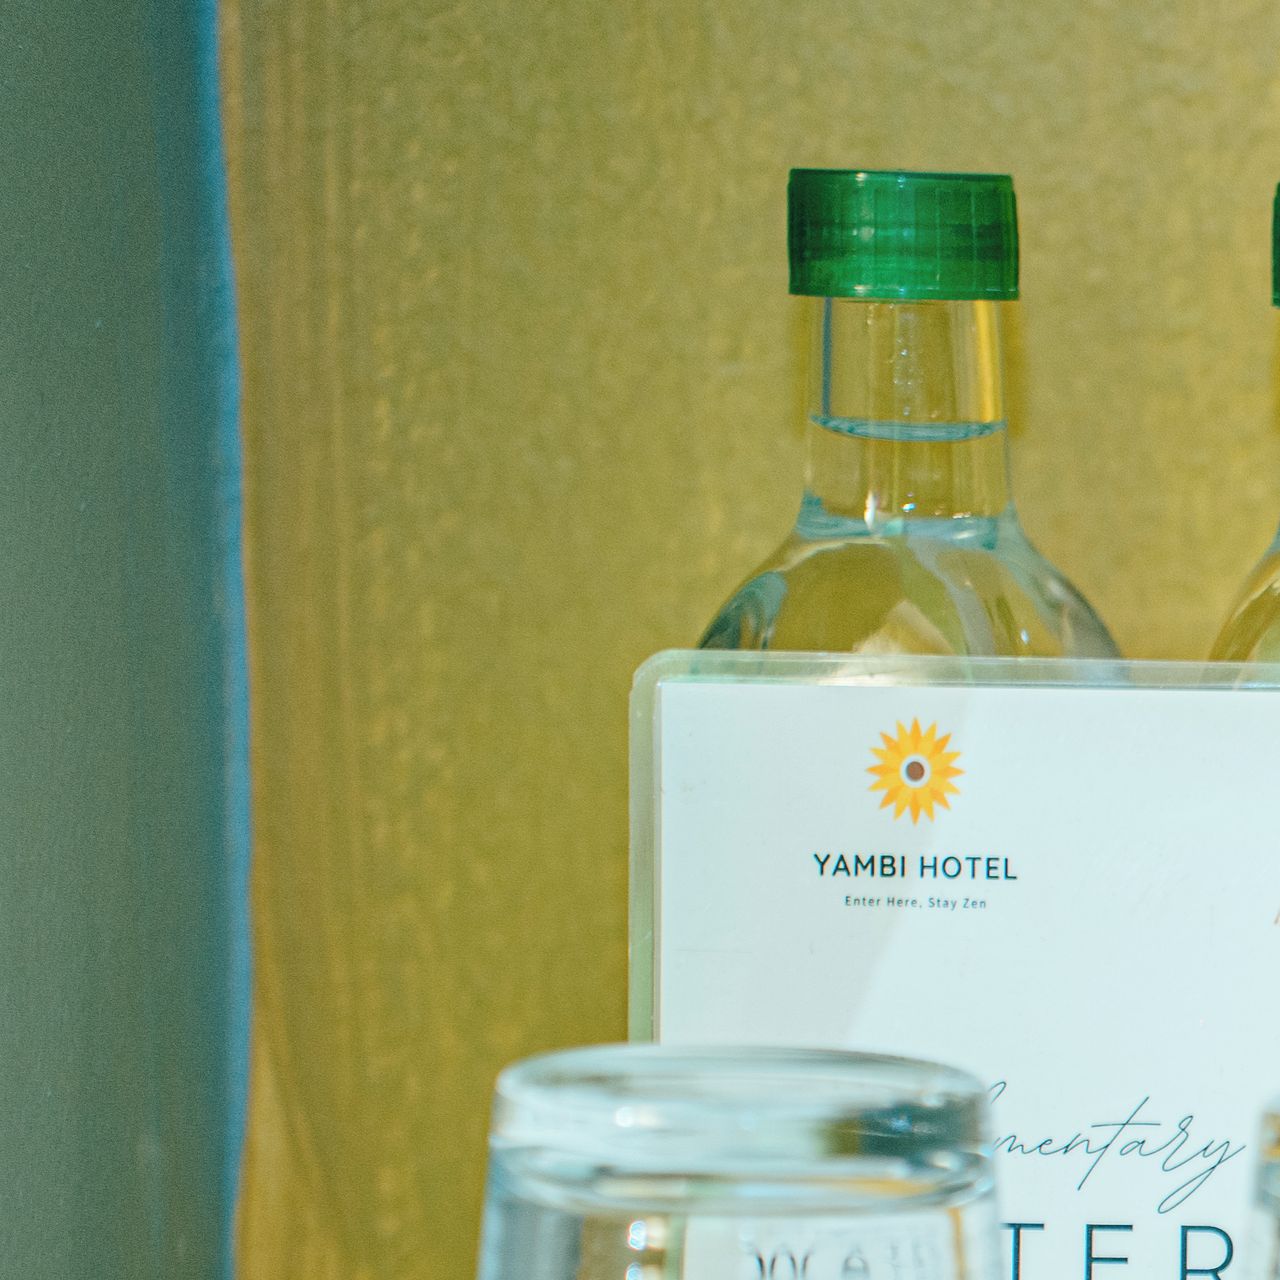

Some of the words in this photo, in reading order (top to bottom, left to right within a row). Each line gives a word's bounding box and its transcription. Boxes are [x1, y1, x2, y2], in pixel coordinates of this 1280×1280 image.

[812, 853, 906, 878] YAMBI
[919, 855, 1018, 880] HOTEL
[844, 896, 881, 907] Enter
[928, 897, 958, 911] Stay
[962, 898, 987, 909] Zen
[990, 1095, 1247, 1214] mentary
